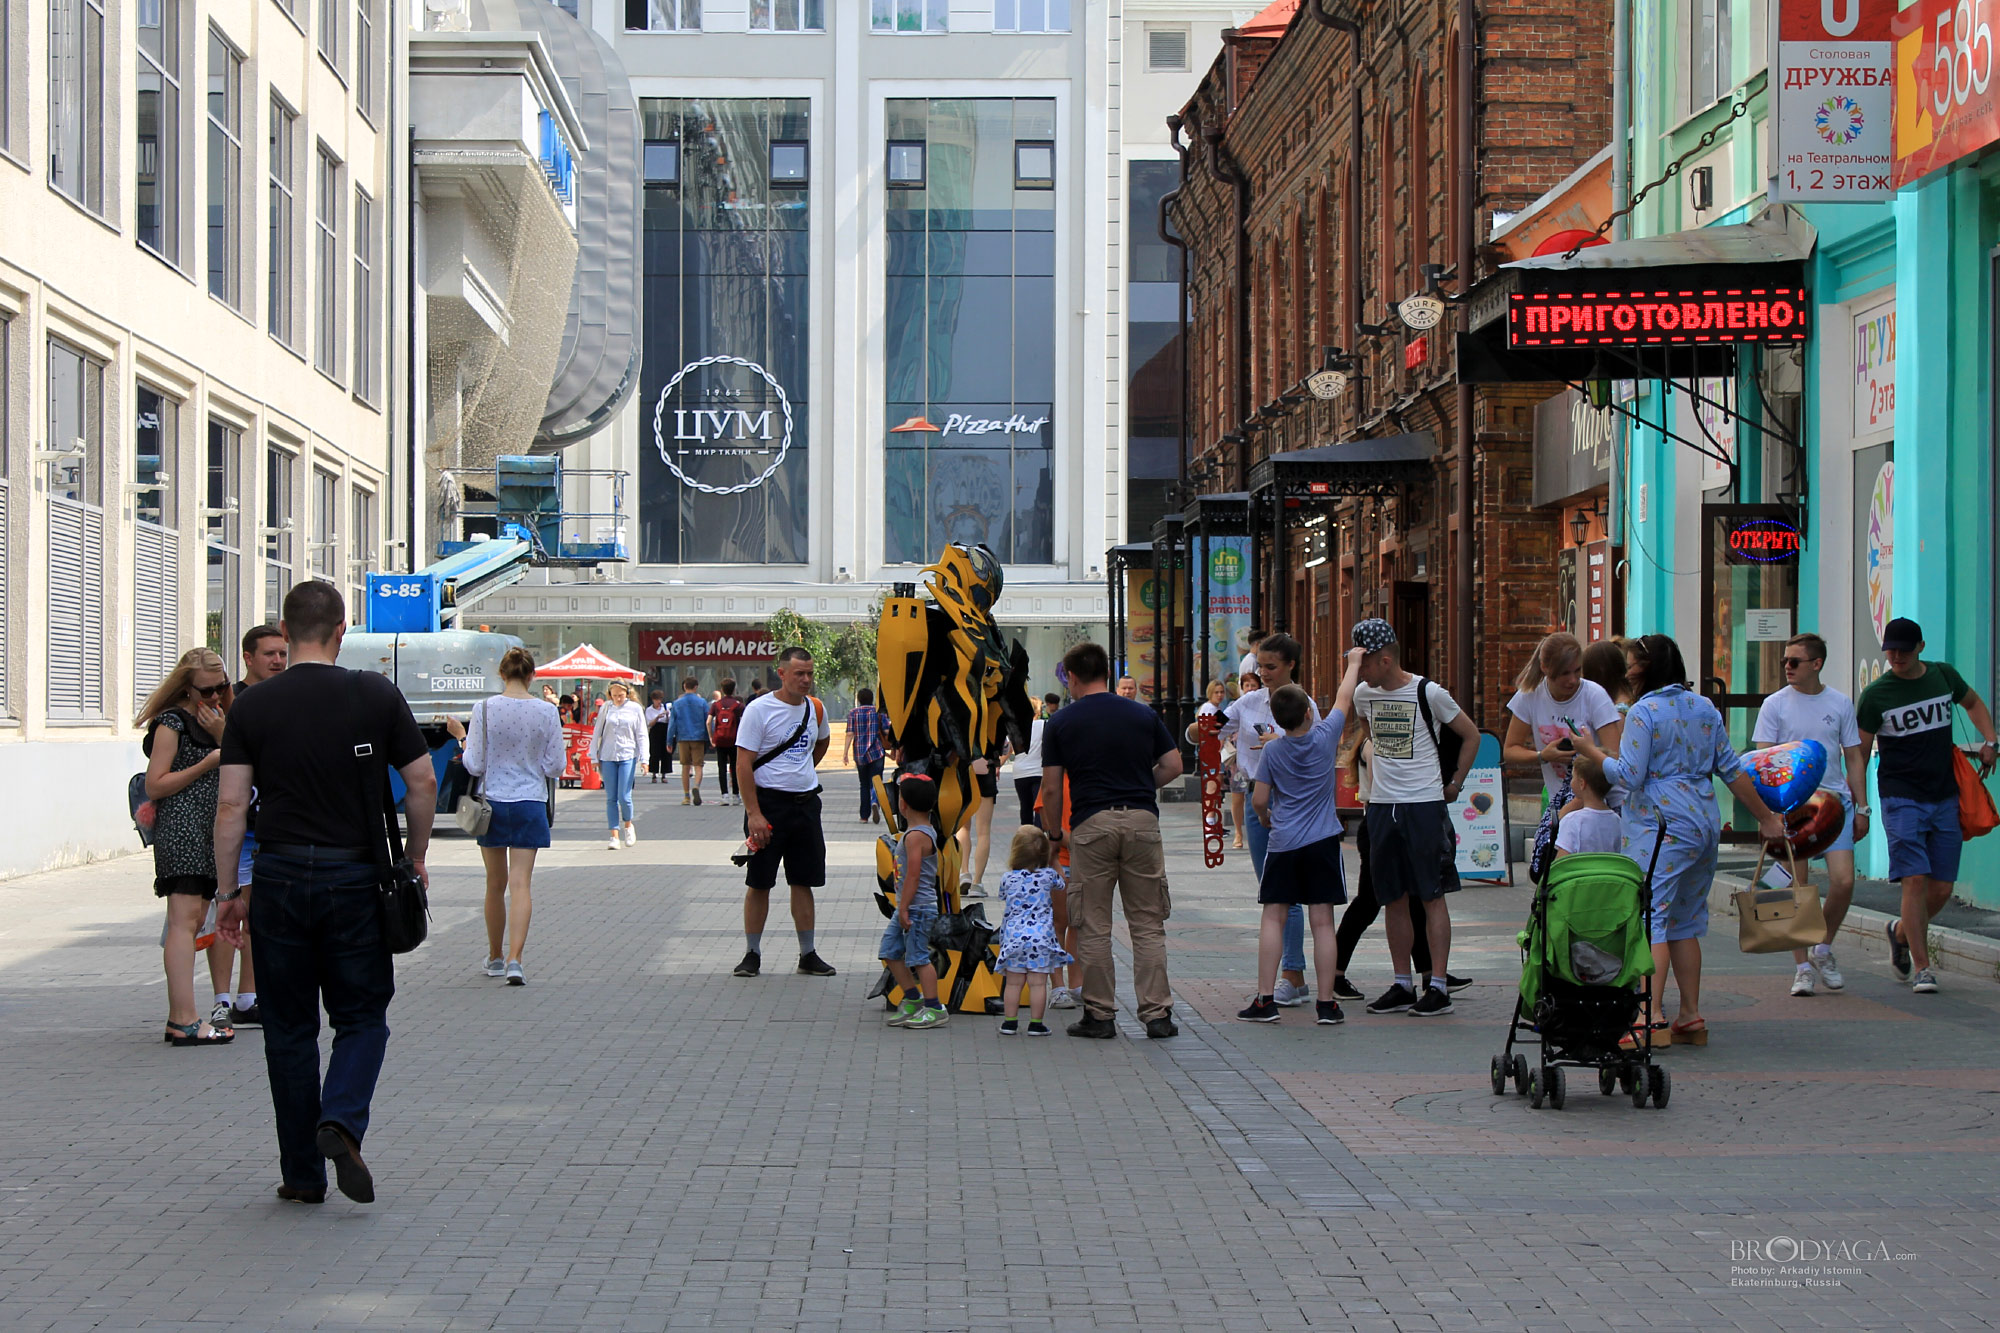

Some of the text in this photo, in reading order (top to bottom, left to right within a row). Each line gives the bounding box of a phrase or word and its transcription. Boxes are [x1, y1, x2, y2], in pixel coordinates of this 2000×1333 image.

[1809, 48, 1871, 60] Столовая
[1933, 0, 1993, 116] 585
[1784, 67, 1892, 90] ДРУЖБА
[1788, 152, 1890, 166] на Театральном
[1786, 169, 1801, 192] 1,
[1809, 169, 1824, 190] 2
[1406, 300, 1438, 310] SURF
[1408, 316, 1436, 325] COFFEE
[1525, 301, 1793, 333] ПРИГОТОВЛЕНО
[1313, 374, 1341, 385] SURF
[706, 388, 741, 396] 1965
[1869, 379, 1877, 425] 2
[674, 410, 773, 443] ЦУМ
[942, 413, 1050, 436] Pizza Hut
[379, 584, 421, 597] S-85
[1209, 594, 1251, 605] panish
[442, 663, 482, 675] Genie
[431, 677, 486, 690] FORTRENT
